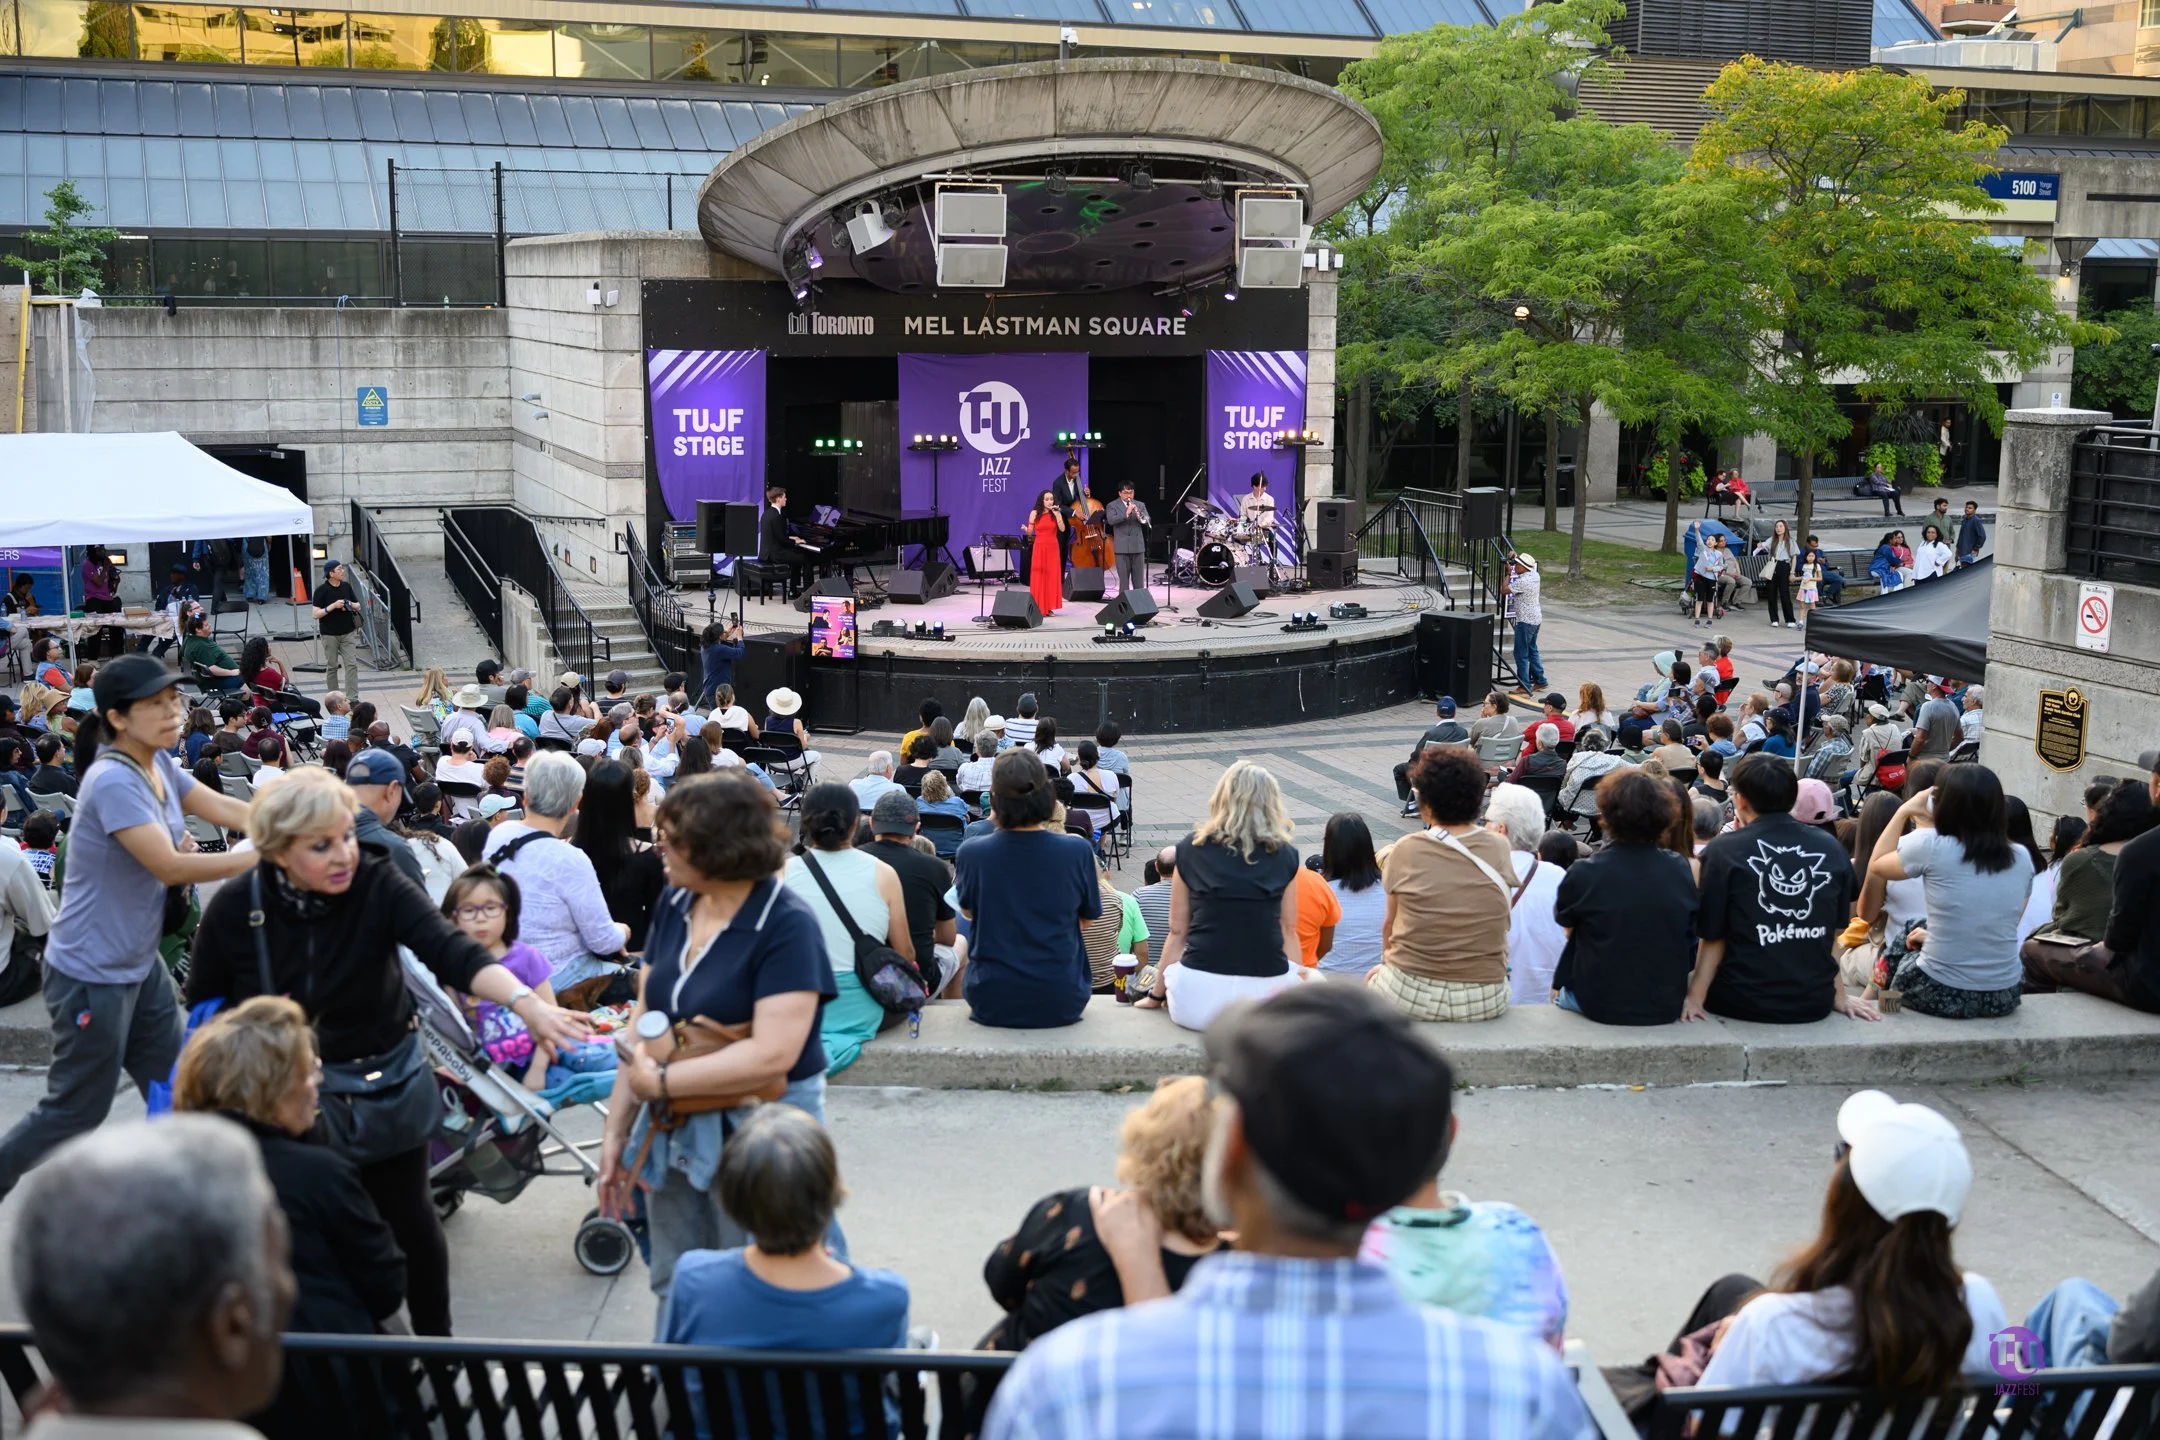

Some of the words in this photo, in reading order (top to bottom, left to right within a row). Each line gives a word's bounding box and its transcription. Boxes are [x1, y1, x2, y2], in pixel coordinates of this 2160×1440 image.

[2012, 180, 2036, 195] 5100
[2039, 188, 2052, 196] Street
[2040, 181, 2052, 189] Yonge
[811, 312, 875, 335] TORONTO
[904, 316, 955, 335] MEL
[963, 316, 1080, 336] LASTMAN
[1088, 316, 1187, 336] SQUARE
[672, 408, 744, 433] TUJF
[1224, 405, 1286, 428] TUJF
[673, 435, 745, 457] STAGE
[979, 457, 1011, 476] JAZZ
[982, 477, 1008, 493] FEST
[1755, 923, 1826, 947] Pokémon
